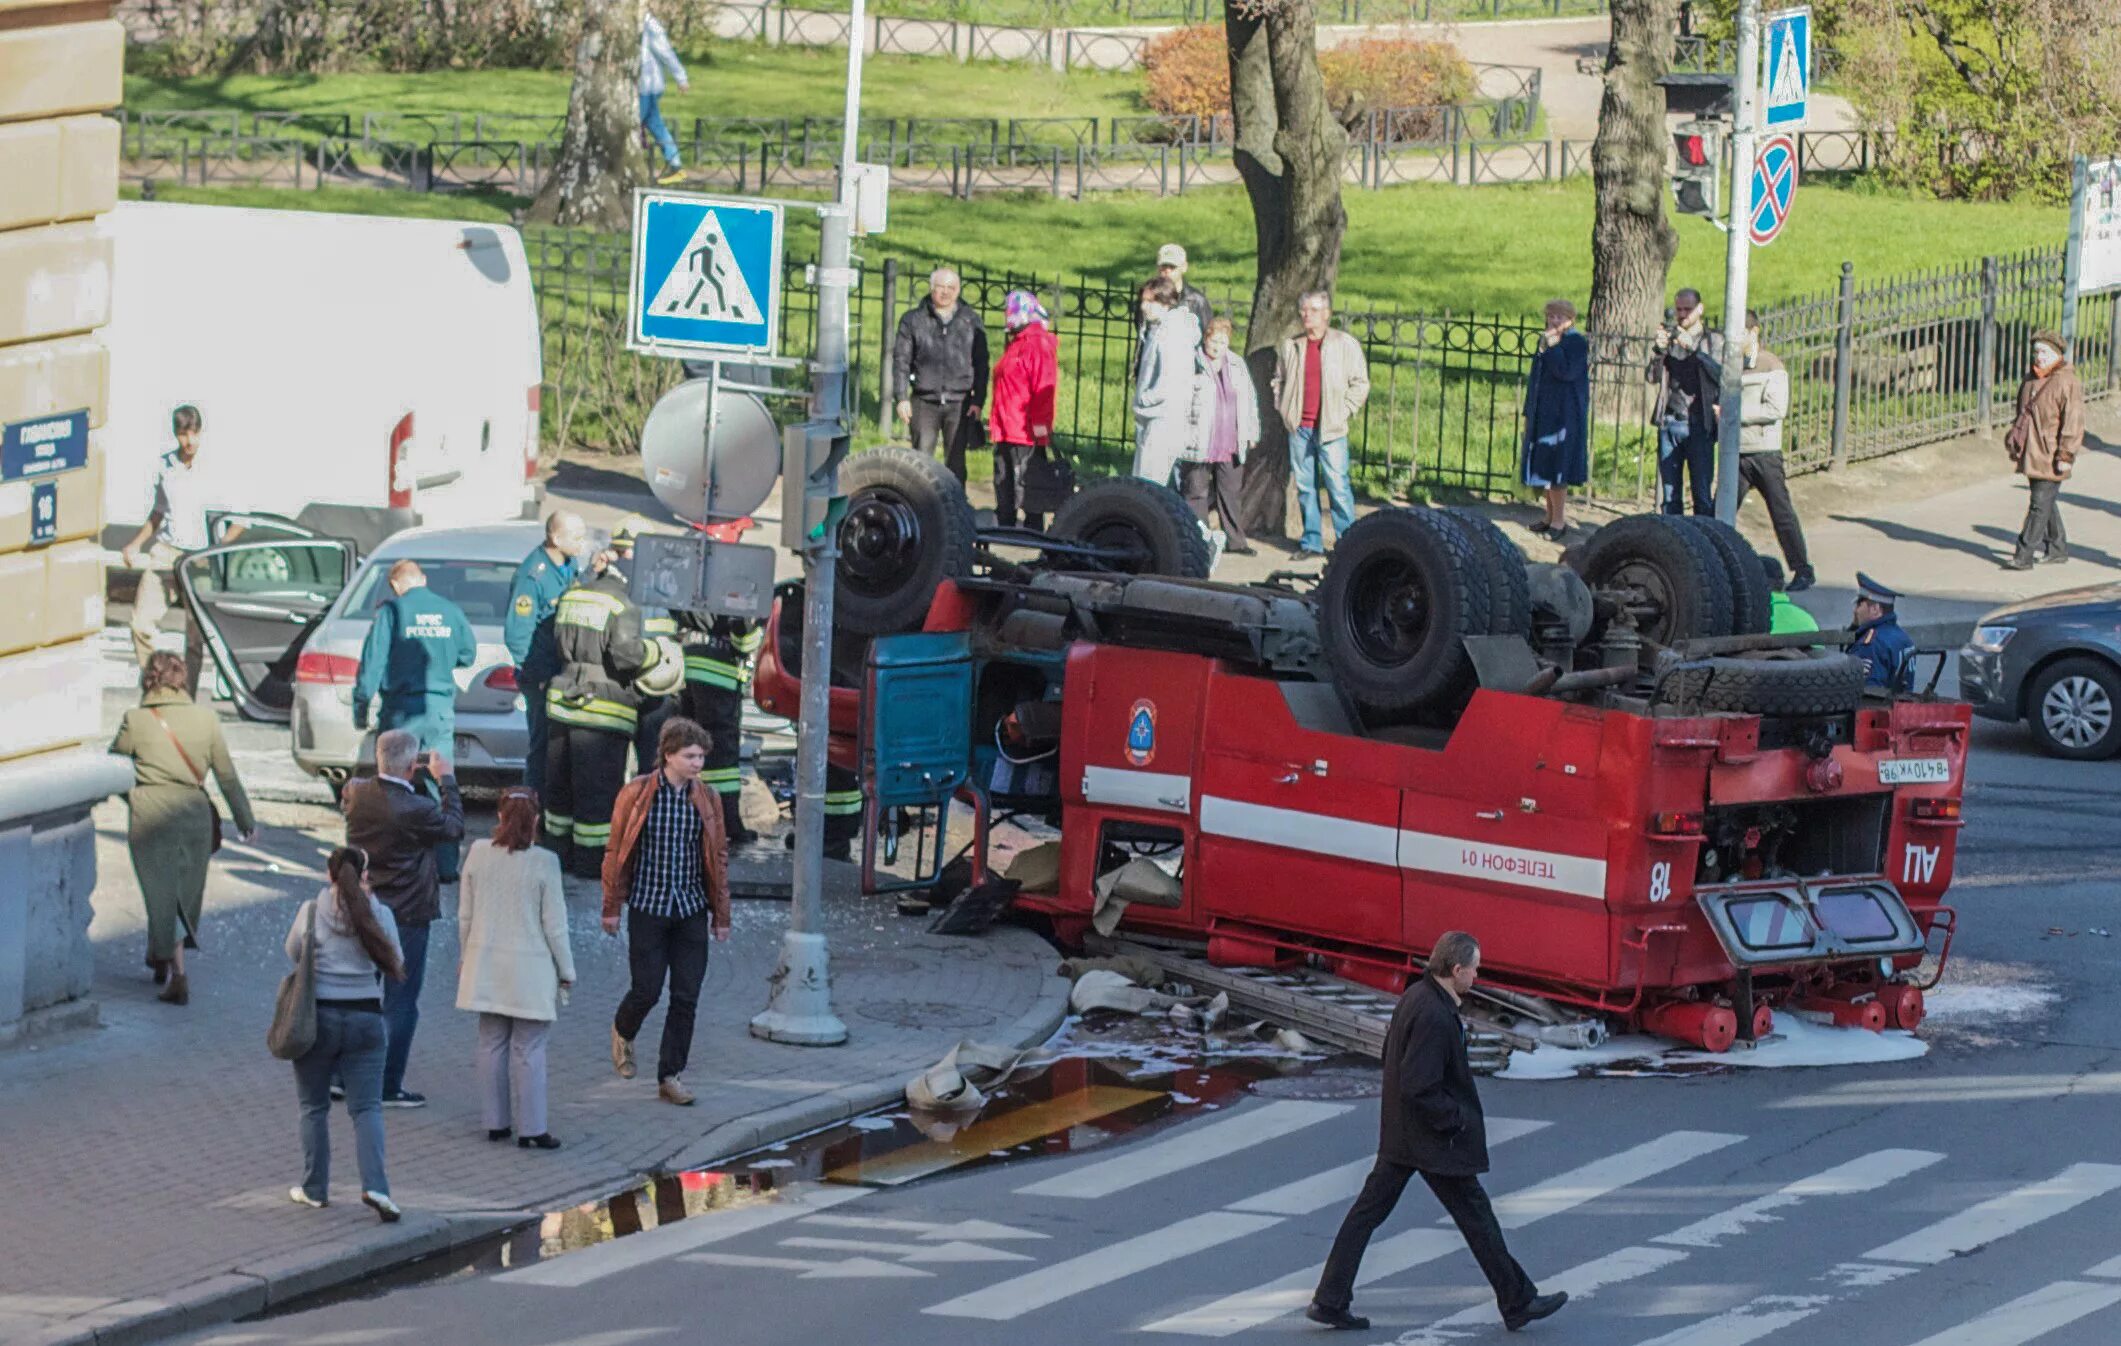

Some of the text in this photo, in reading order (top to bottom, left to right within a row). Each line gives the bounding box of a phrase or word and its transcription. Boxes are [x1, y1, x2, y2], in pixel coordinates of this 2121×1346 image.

[1462, 848, 1556, 880] ТЕЛЕФОН 01
[1650, 861, 1671, 902] 18
[1903, 842, 1940, 884] АЦ
